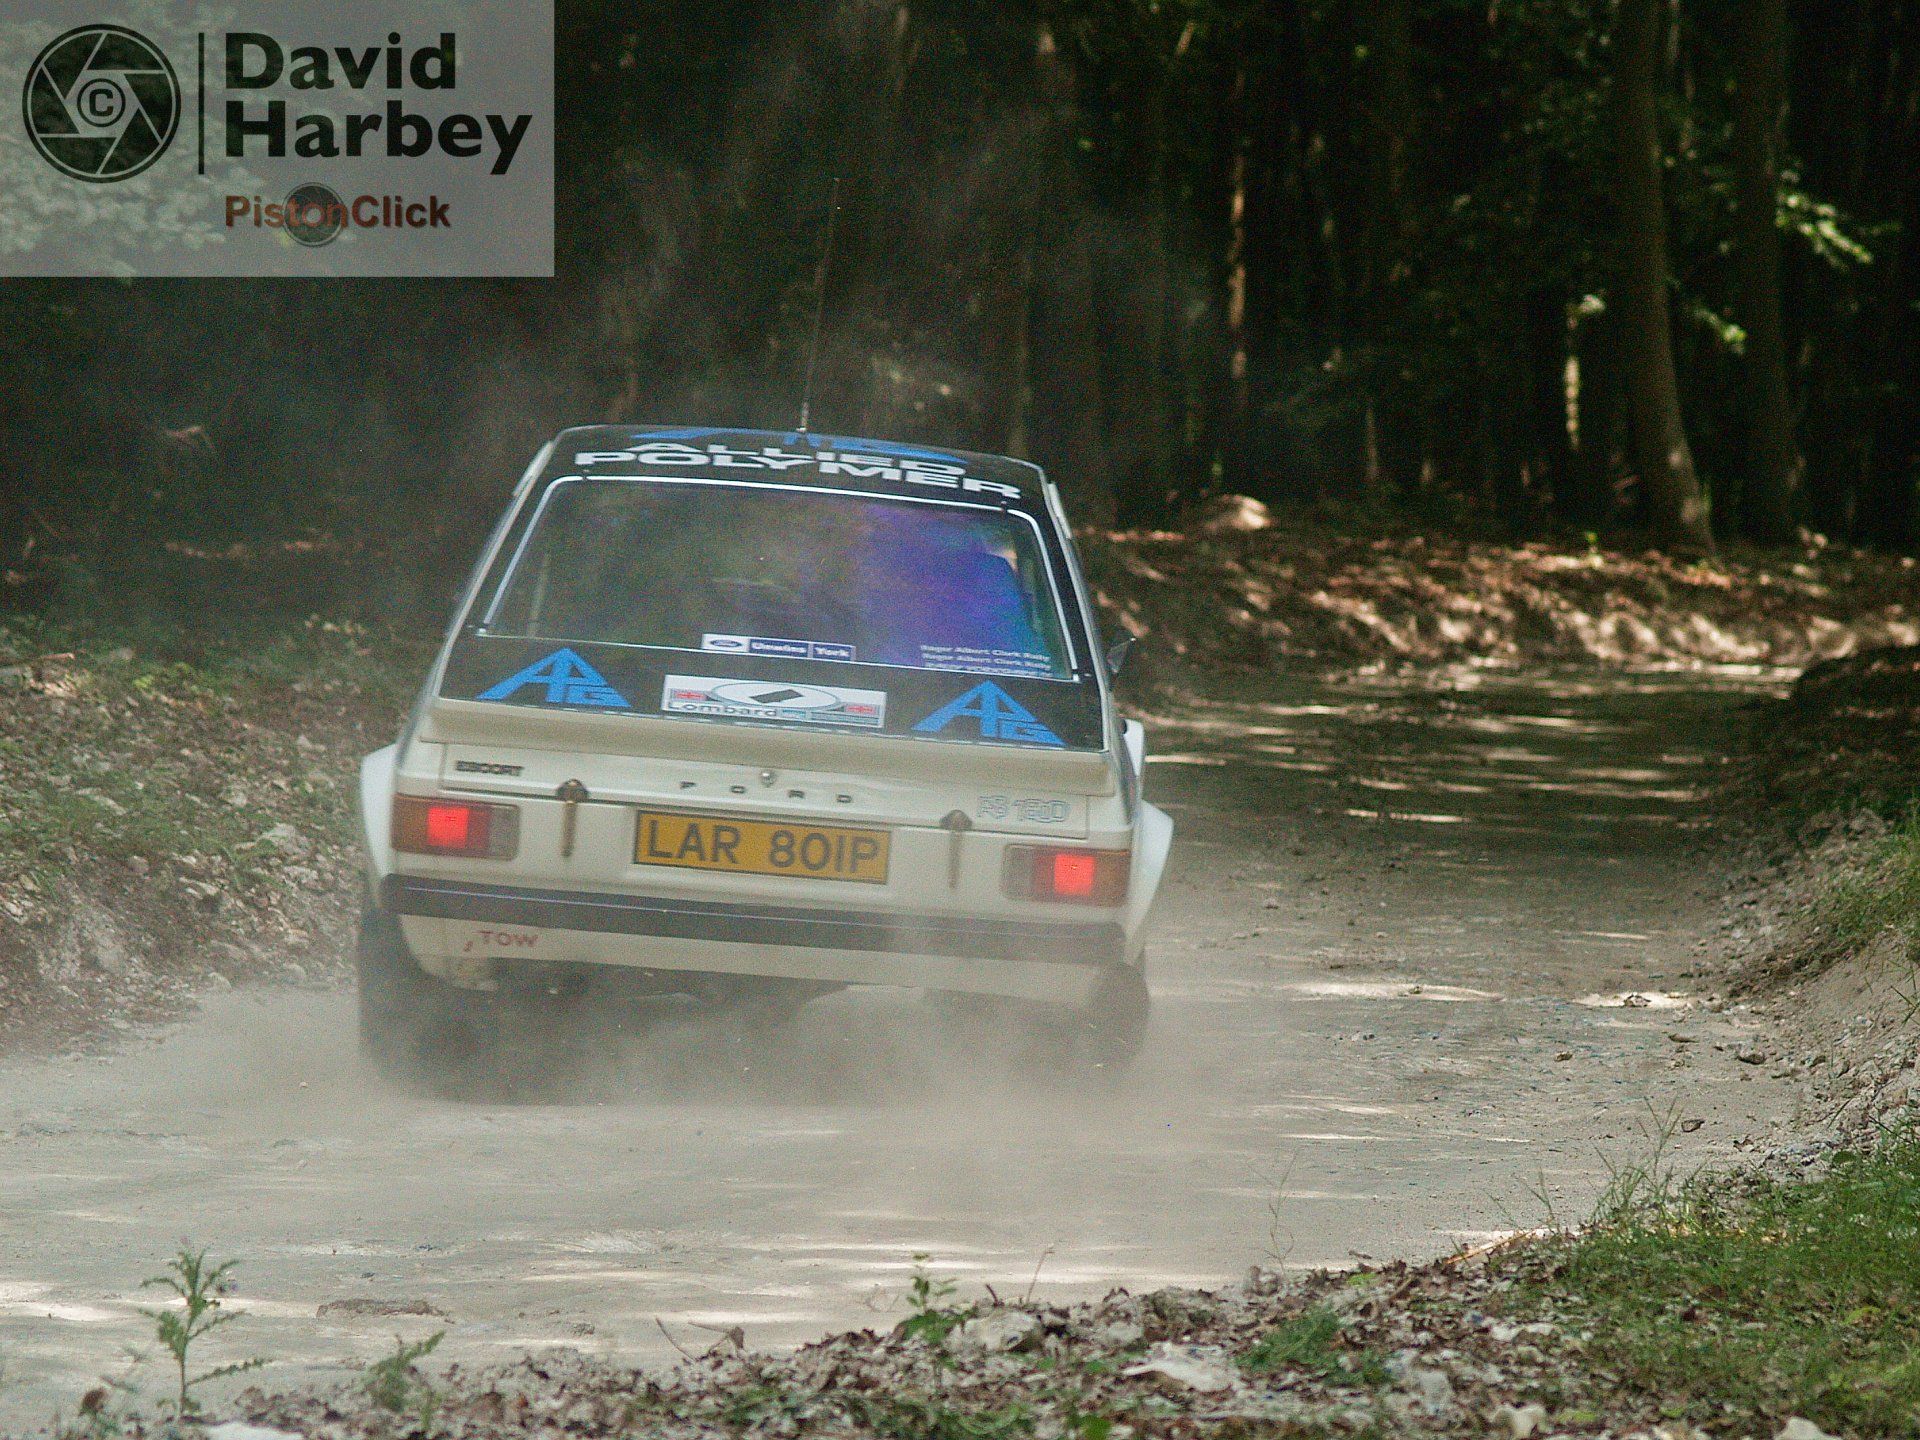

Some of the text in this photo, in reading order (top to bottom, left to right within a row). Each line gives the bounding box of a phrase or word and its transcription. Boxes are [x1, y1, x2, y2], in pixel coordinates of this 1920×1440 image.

[575, 451, 1021, 499] POLYMER
[627, 442, 966, 476] ALLIED
[667, 701, 778, 718] Lombard
[648, 819, 879, 873] LAR 801P
